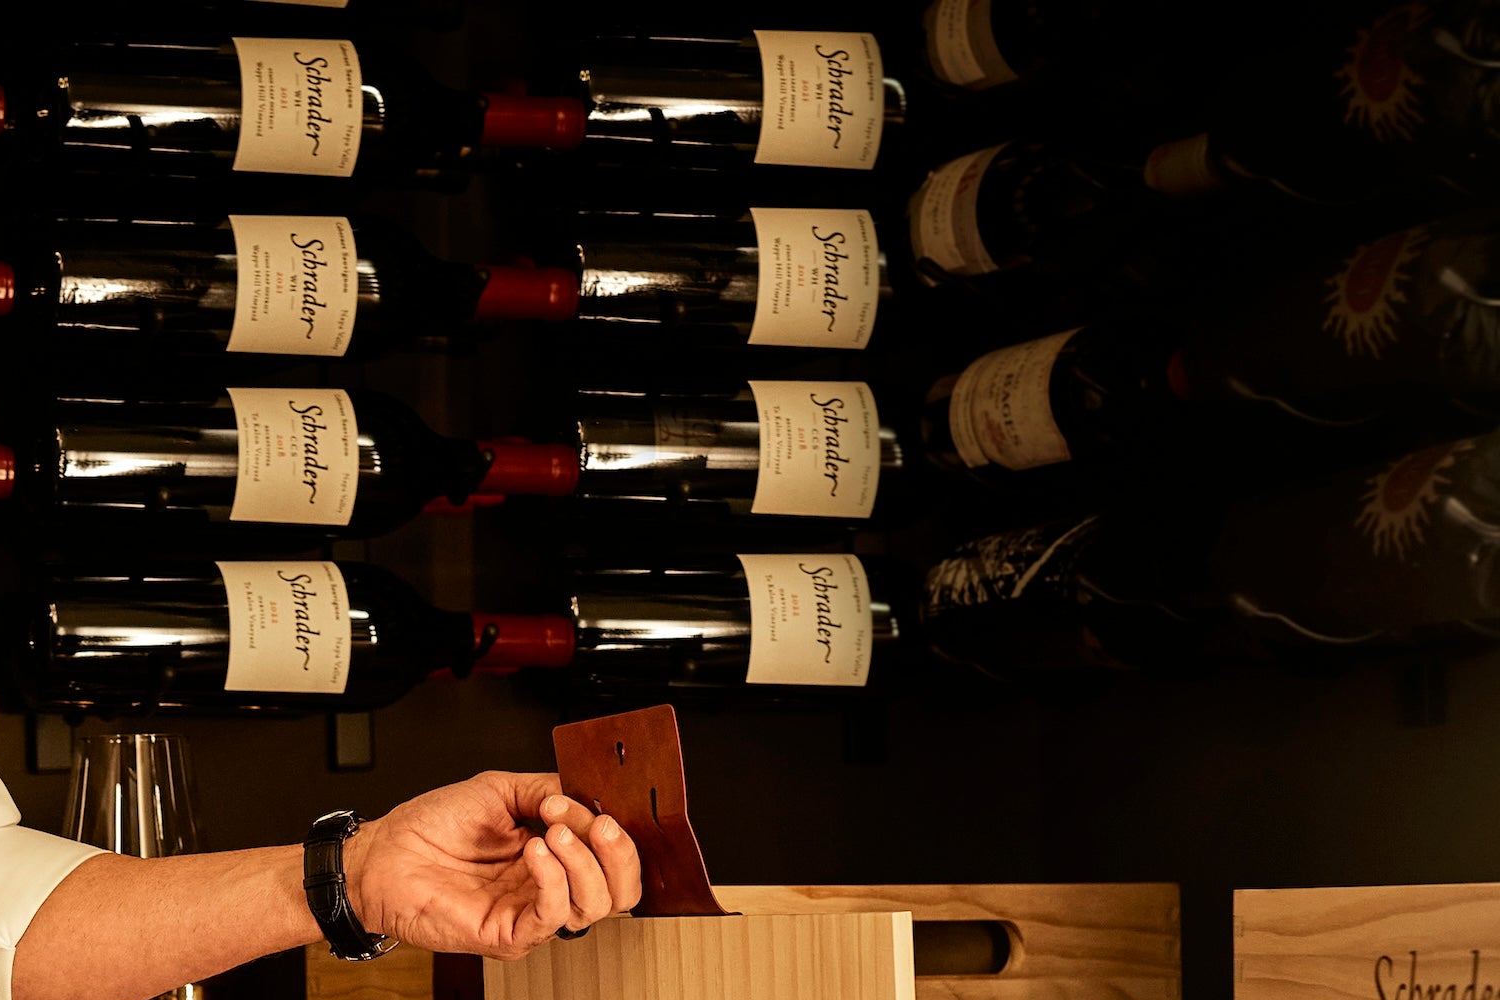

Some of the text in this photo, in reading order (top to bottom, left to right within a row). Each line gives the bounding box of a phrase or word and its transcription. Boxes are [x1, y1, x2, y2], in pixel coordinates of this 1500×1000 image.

[293, 52, 332, 156] Schrader
[294, 90, 302, 107] WH
[815, 83, 823, 100] WH
[815, 45, 853, 149] Schrader
[290, 275, 297, 292] WH
[290, 233, 327, 339] Schrader
[811, 267, 819, 285] WH
[812, 225, 849, 333] Schrader
[288, 400, 328, 504] Schrader
[290, 435, 298, 457] CCS
[810, 393, 850, 497] Schrader
[277, 570, 321, 671] Schrader
[799, 563, 842, 664] Schrader
